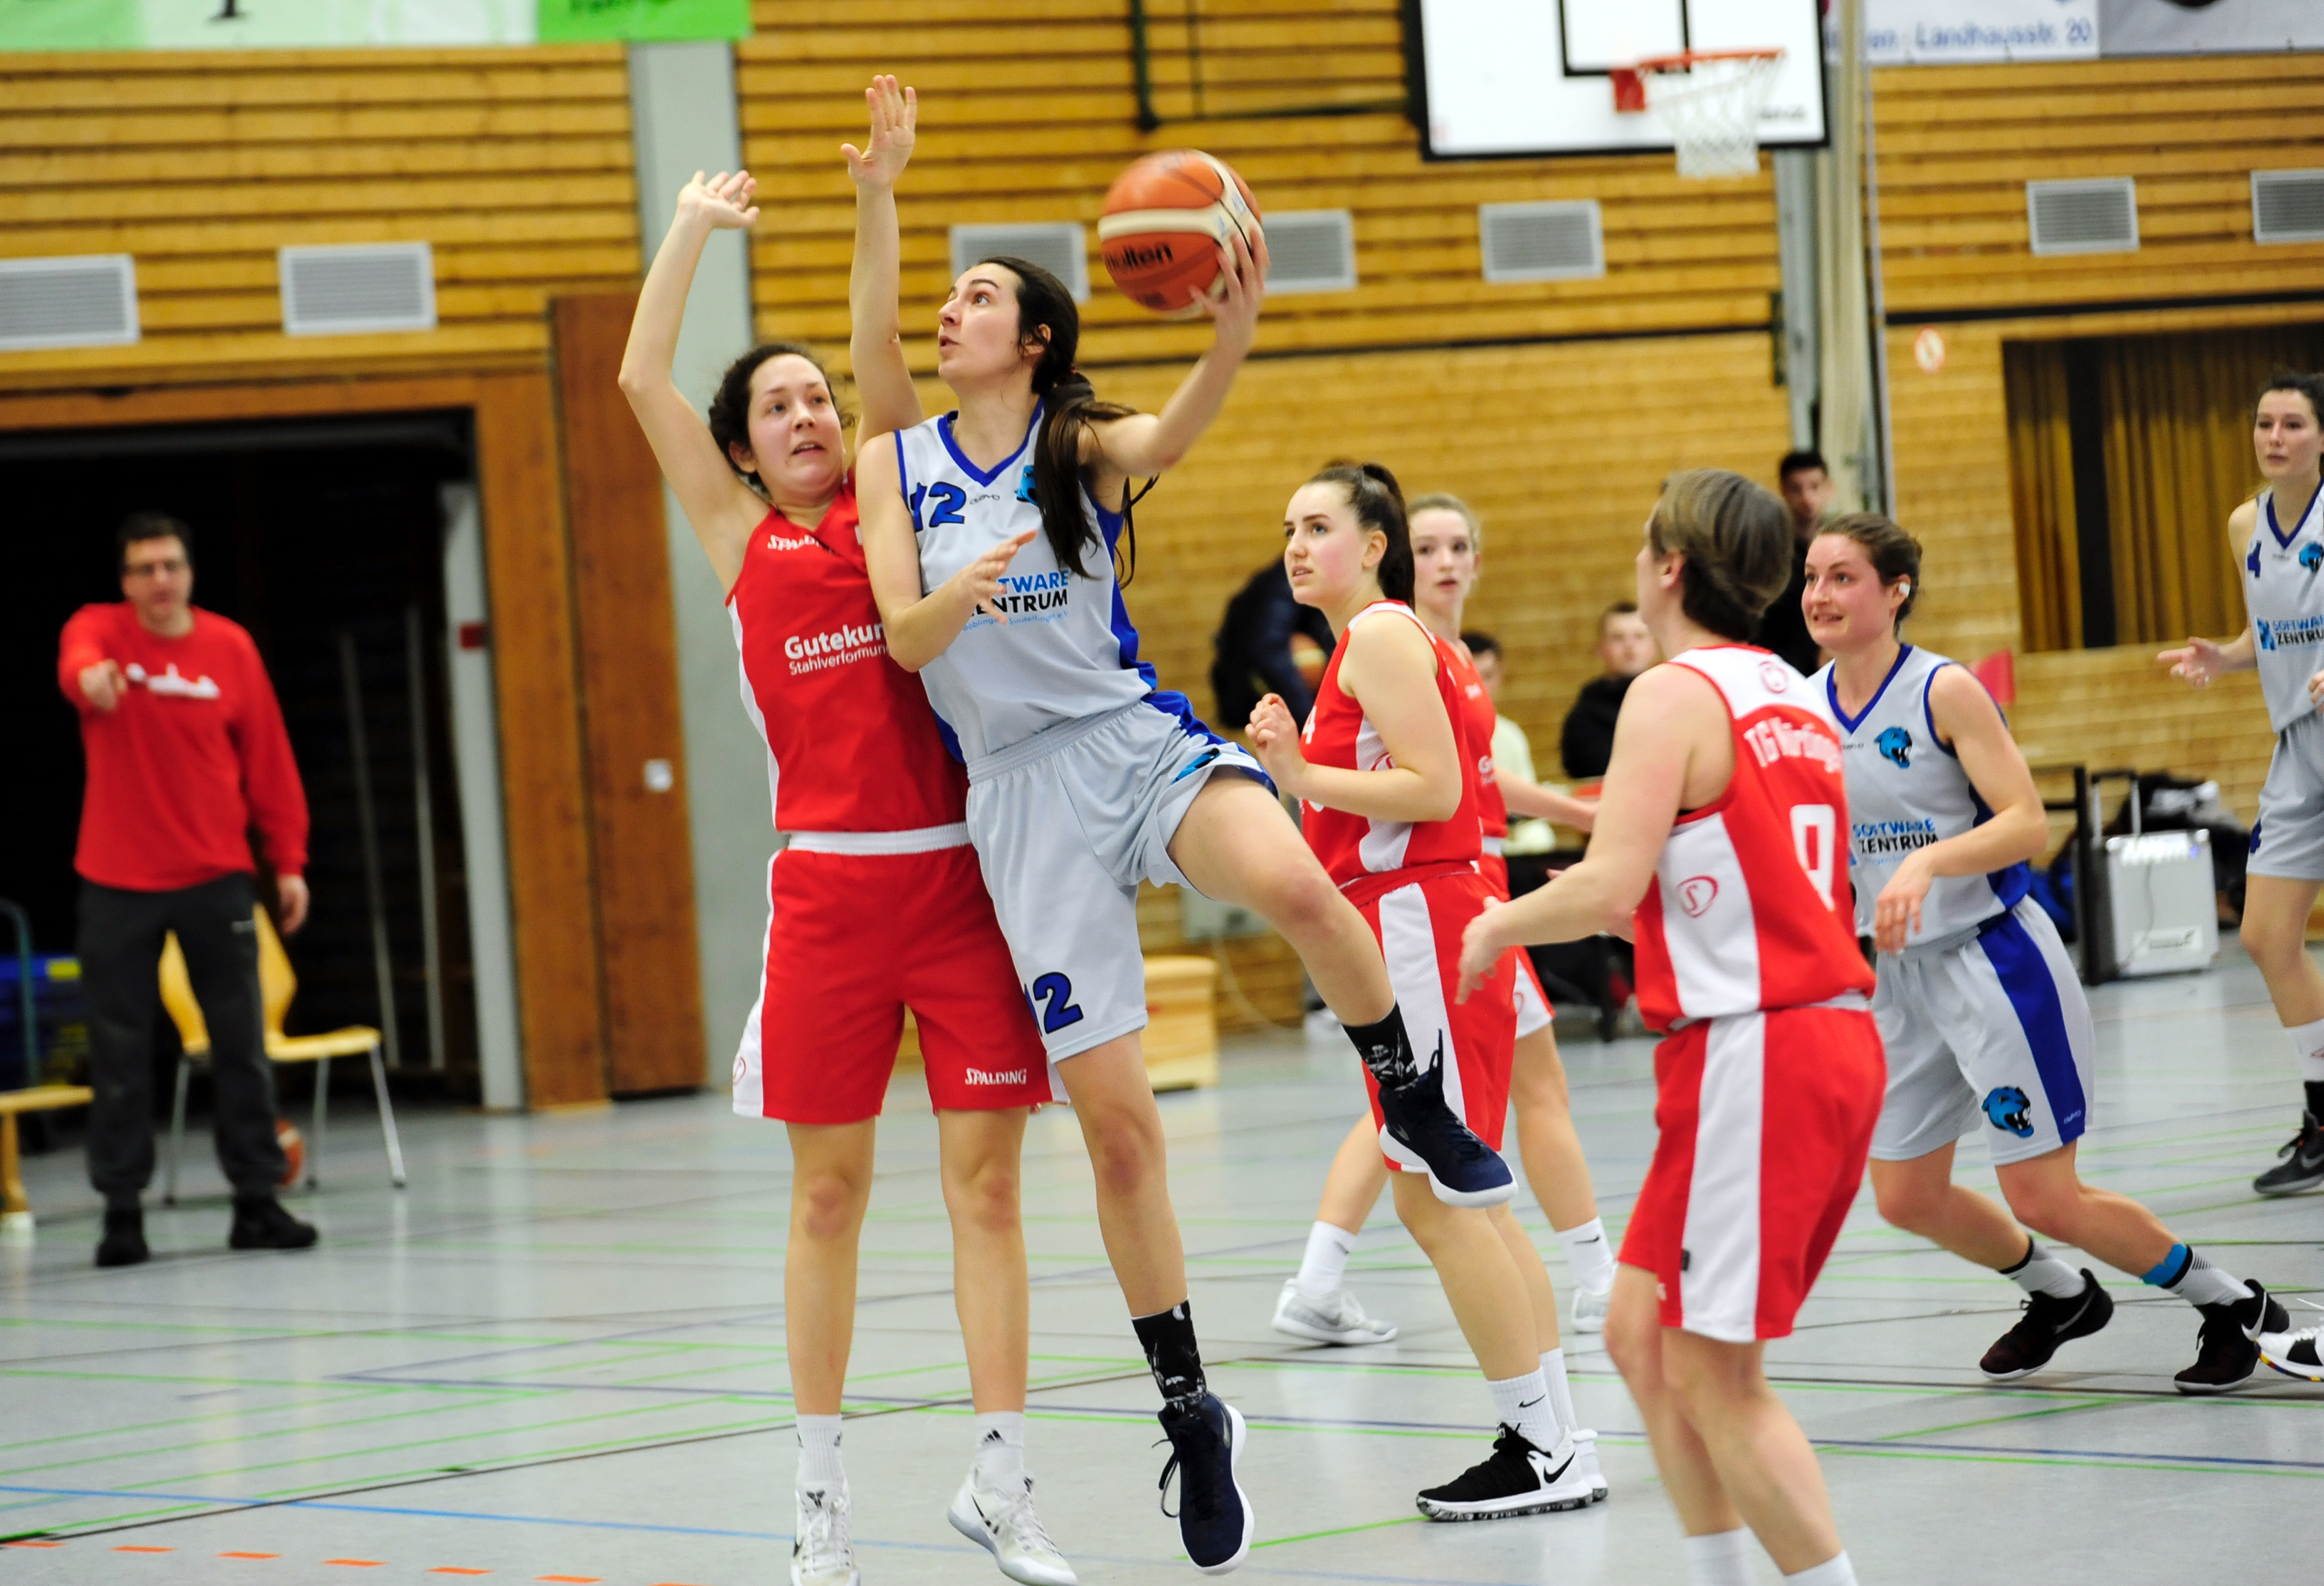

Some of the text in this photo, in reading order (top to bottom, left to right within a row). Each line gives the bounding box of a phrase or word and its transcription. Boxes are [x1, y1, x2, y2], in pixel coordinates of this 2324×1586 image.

[910, 482, 966, 533] 12
[997, 569, 1071, 595] TWARE
[1024, 971, 1084, 1037] 2
[965, 1068, 1027, 1085] SPALDING
